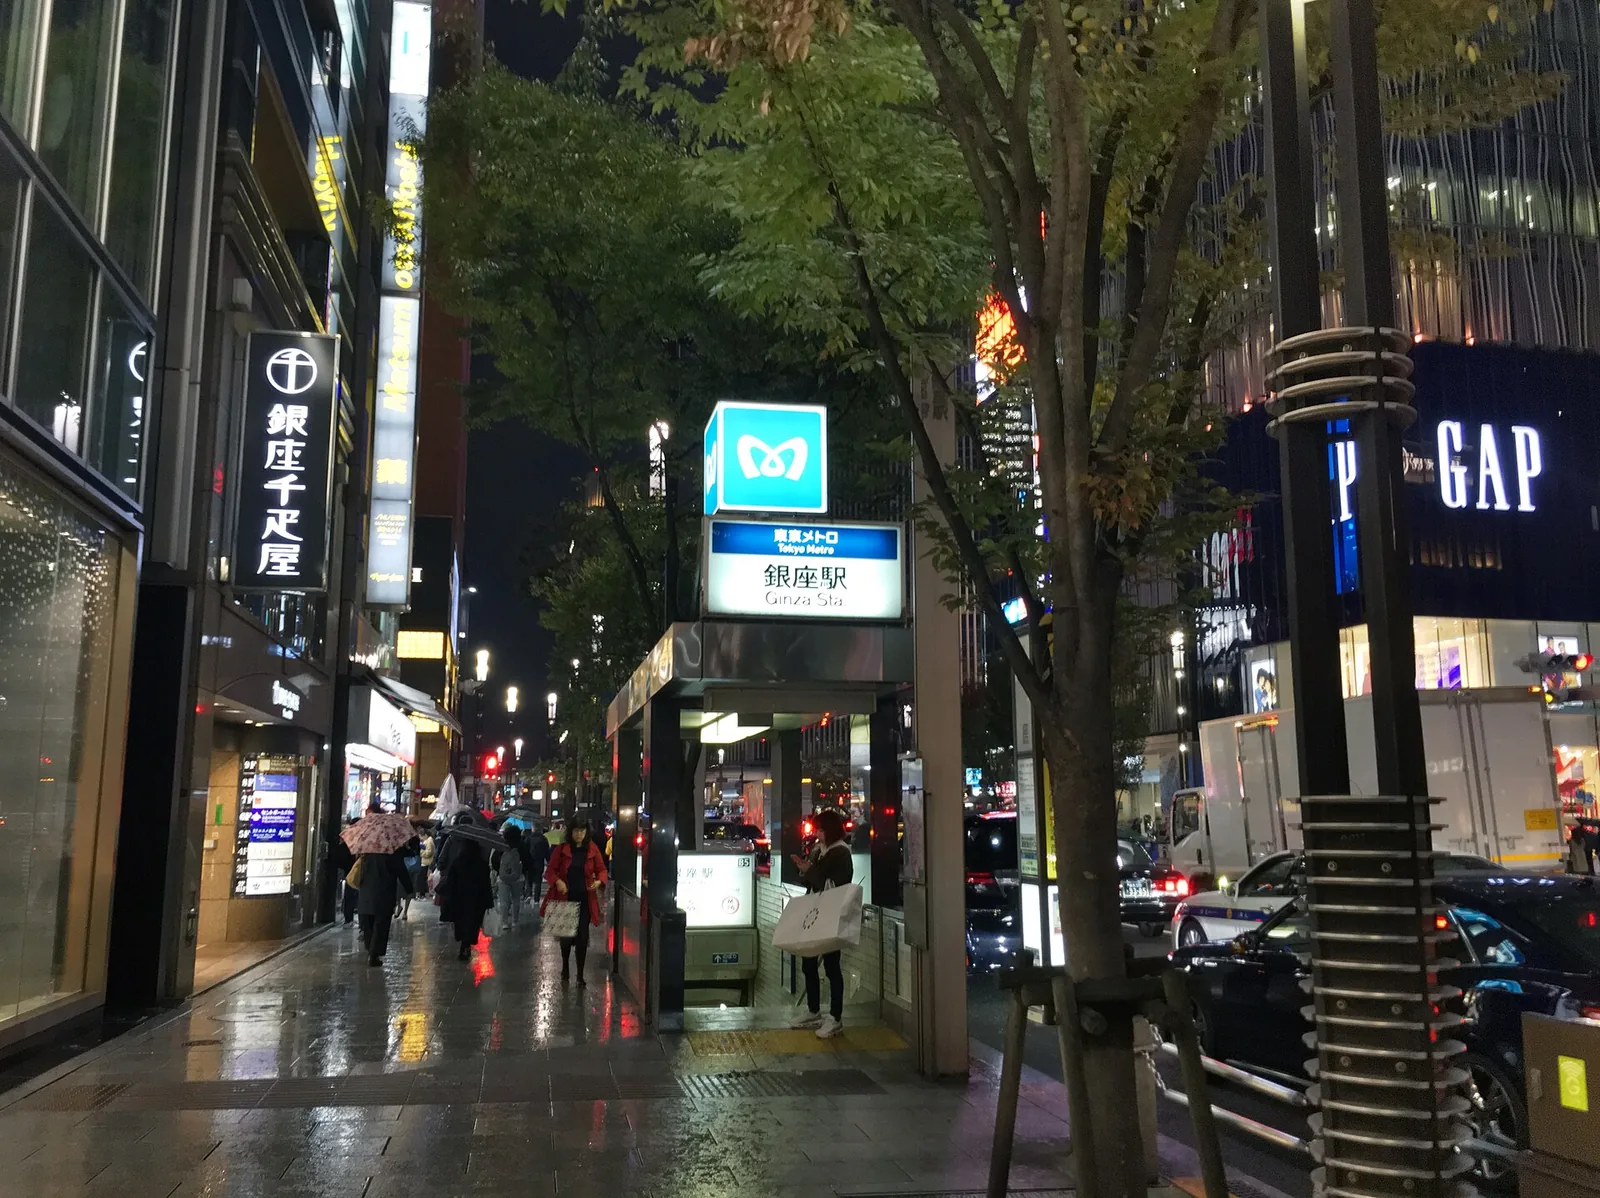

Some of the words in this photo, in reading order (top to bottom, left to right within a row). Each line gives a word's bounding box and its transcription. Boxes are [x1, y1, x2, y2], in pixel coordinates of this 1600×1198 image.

[1436, 420, 1542, 512] GAP
[257, 403, 310, 577] 銀座千疋屋
[773, 528, 838, 545] 東京メトロ
[777, 542, 805, 556] Tokyo
[806, 543, 835, 556] Metro
[764, 563, 848, 590] 銀座駅
[765, 591, 811, 607] Ginza
[738, 858, 750, 867] B5
